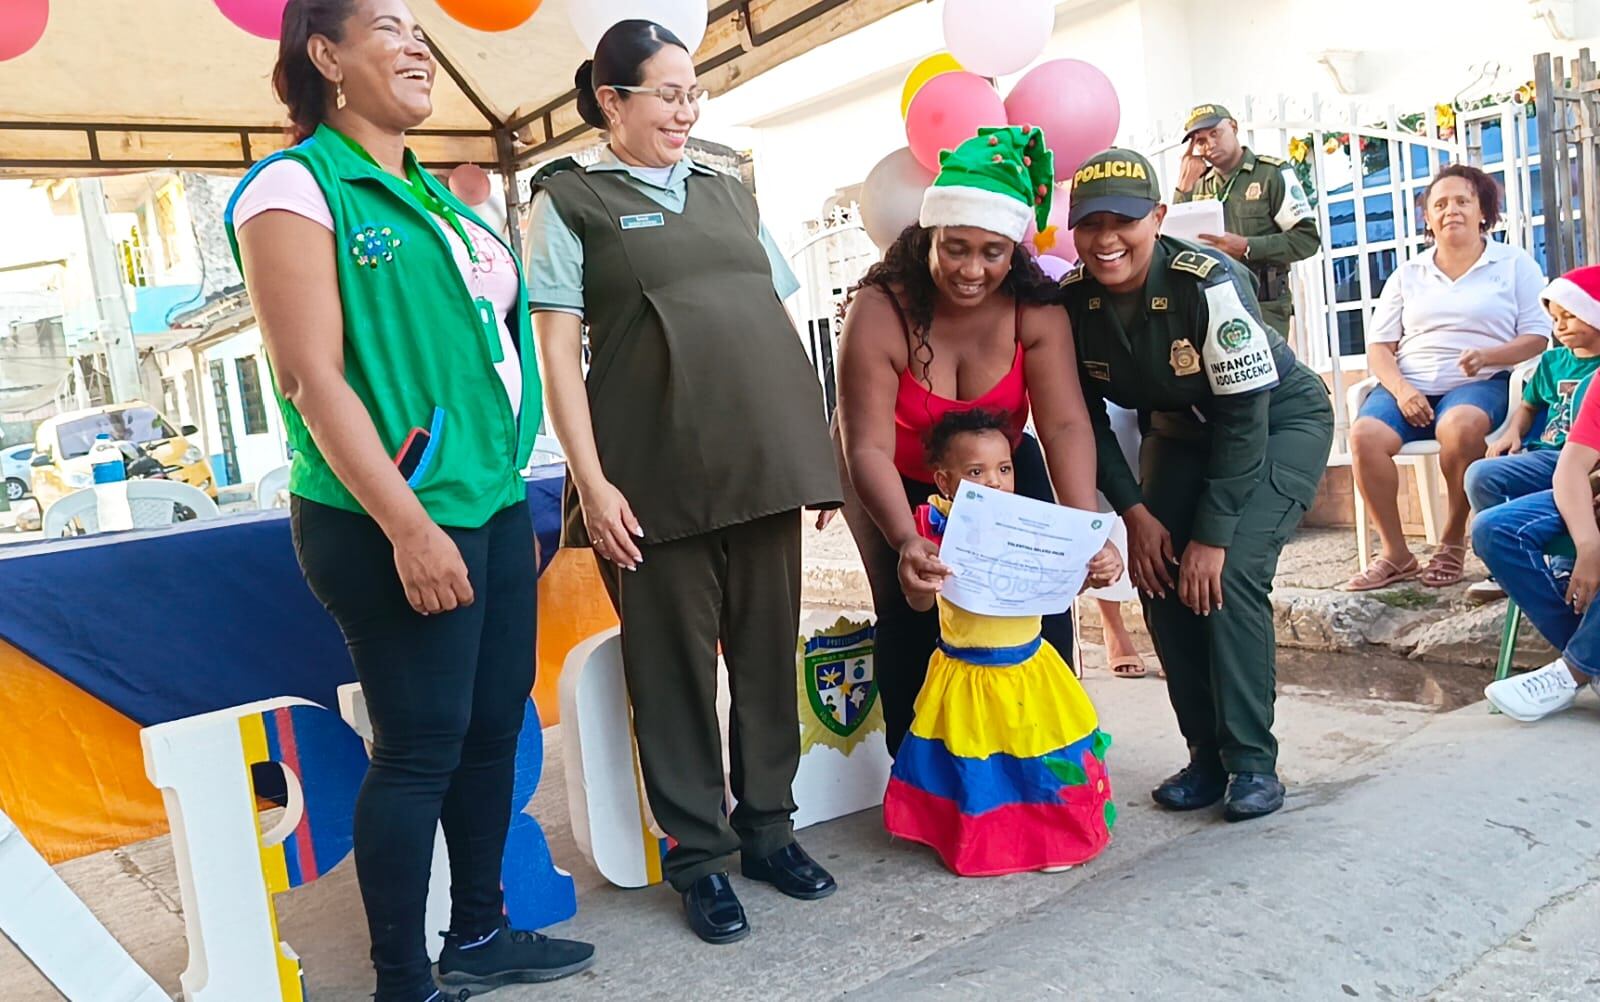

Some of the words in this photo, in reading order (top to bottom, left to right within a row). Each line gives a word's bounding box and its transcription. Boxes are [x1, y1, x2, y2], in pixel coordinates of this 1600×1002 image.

[1073, 161, 1147, 189] POLICIA
[1210, 351, 1262, 374] INFANCIA
[1262, 349, 1269, 360] Y
